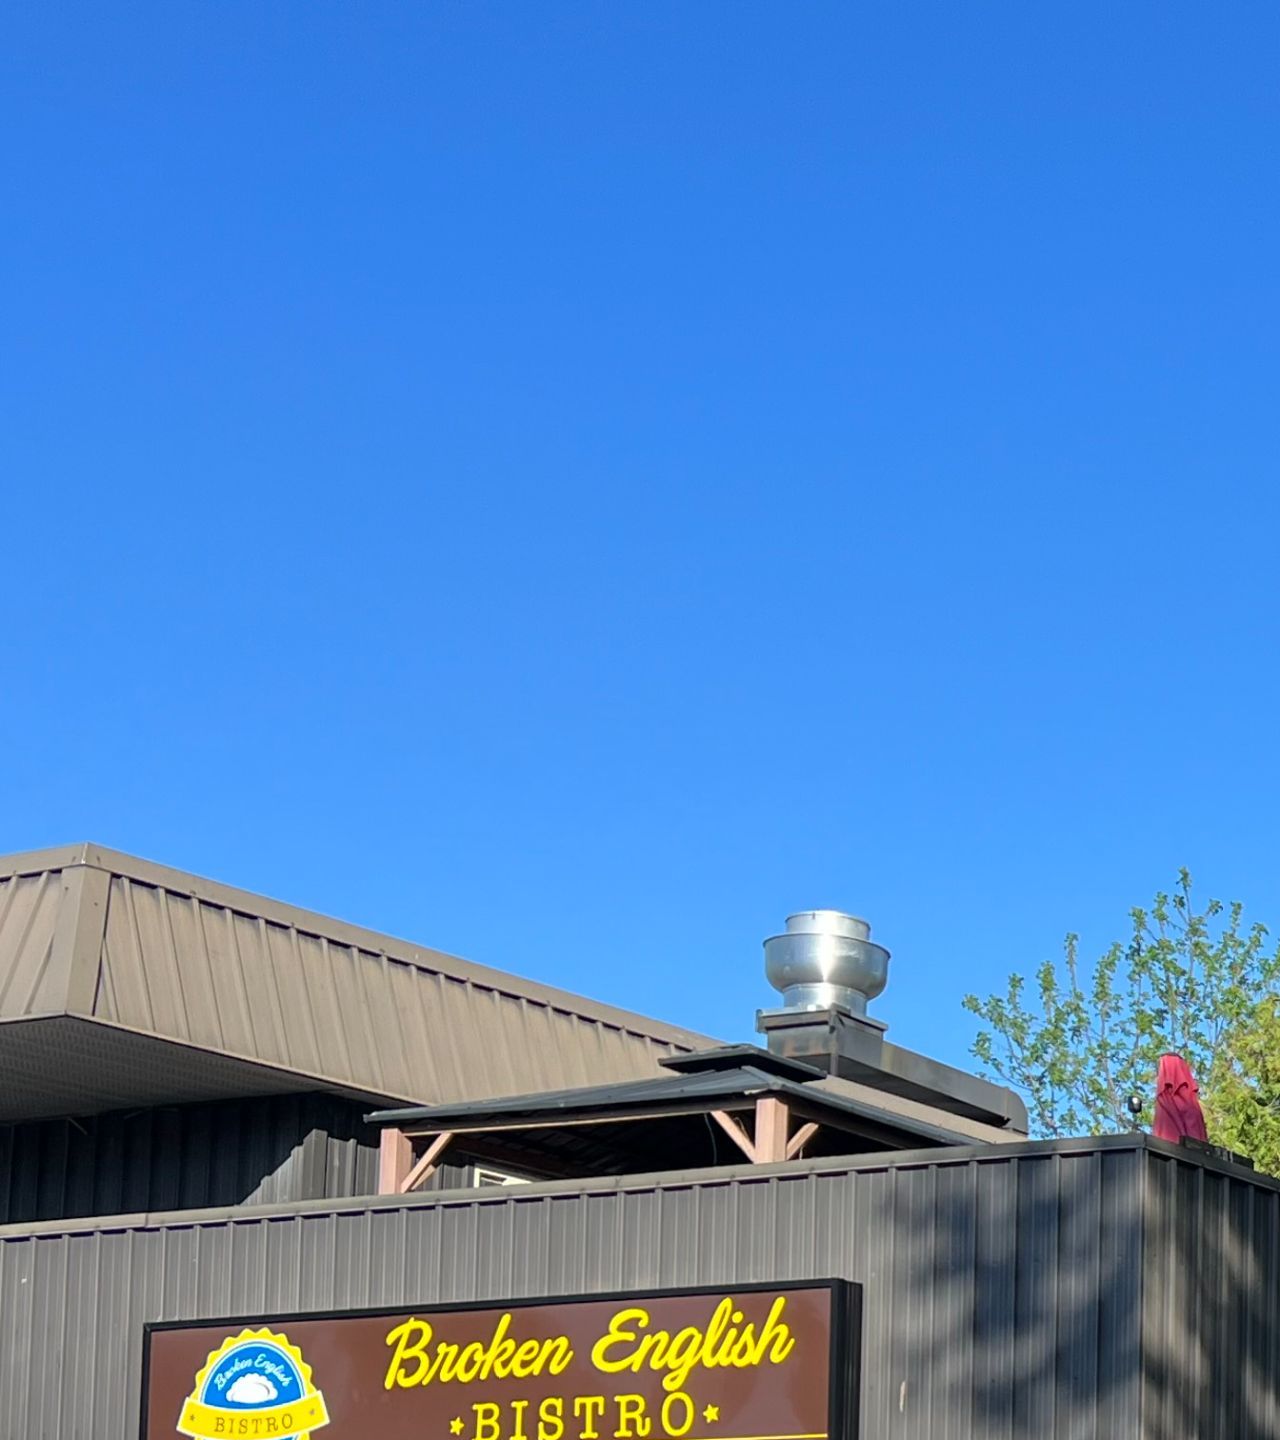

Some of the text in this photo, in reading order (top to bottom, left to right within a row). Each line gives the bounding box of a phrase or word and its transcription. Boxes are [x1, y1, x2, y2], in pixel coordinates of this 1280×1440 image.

[384, 1296, 796, 1391] Broken English
[214, 1353, 293, 1390] Broken English
[214, 1413, 294, 1434] BISTRO
